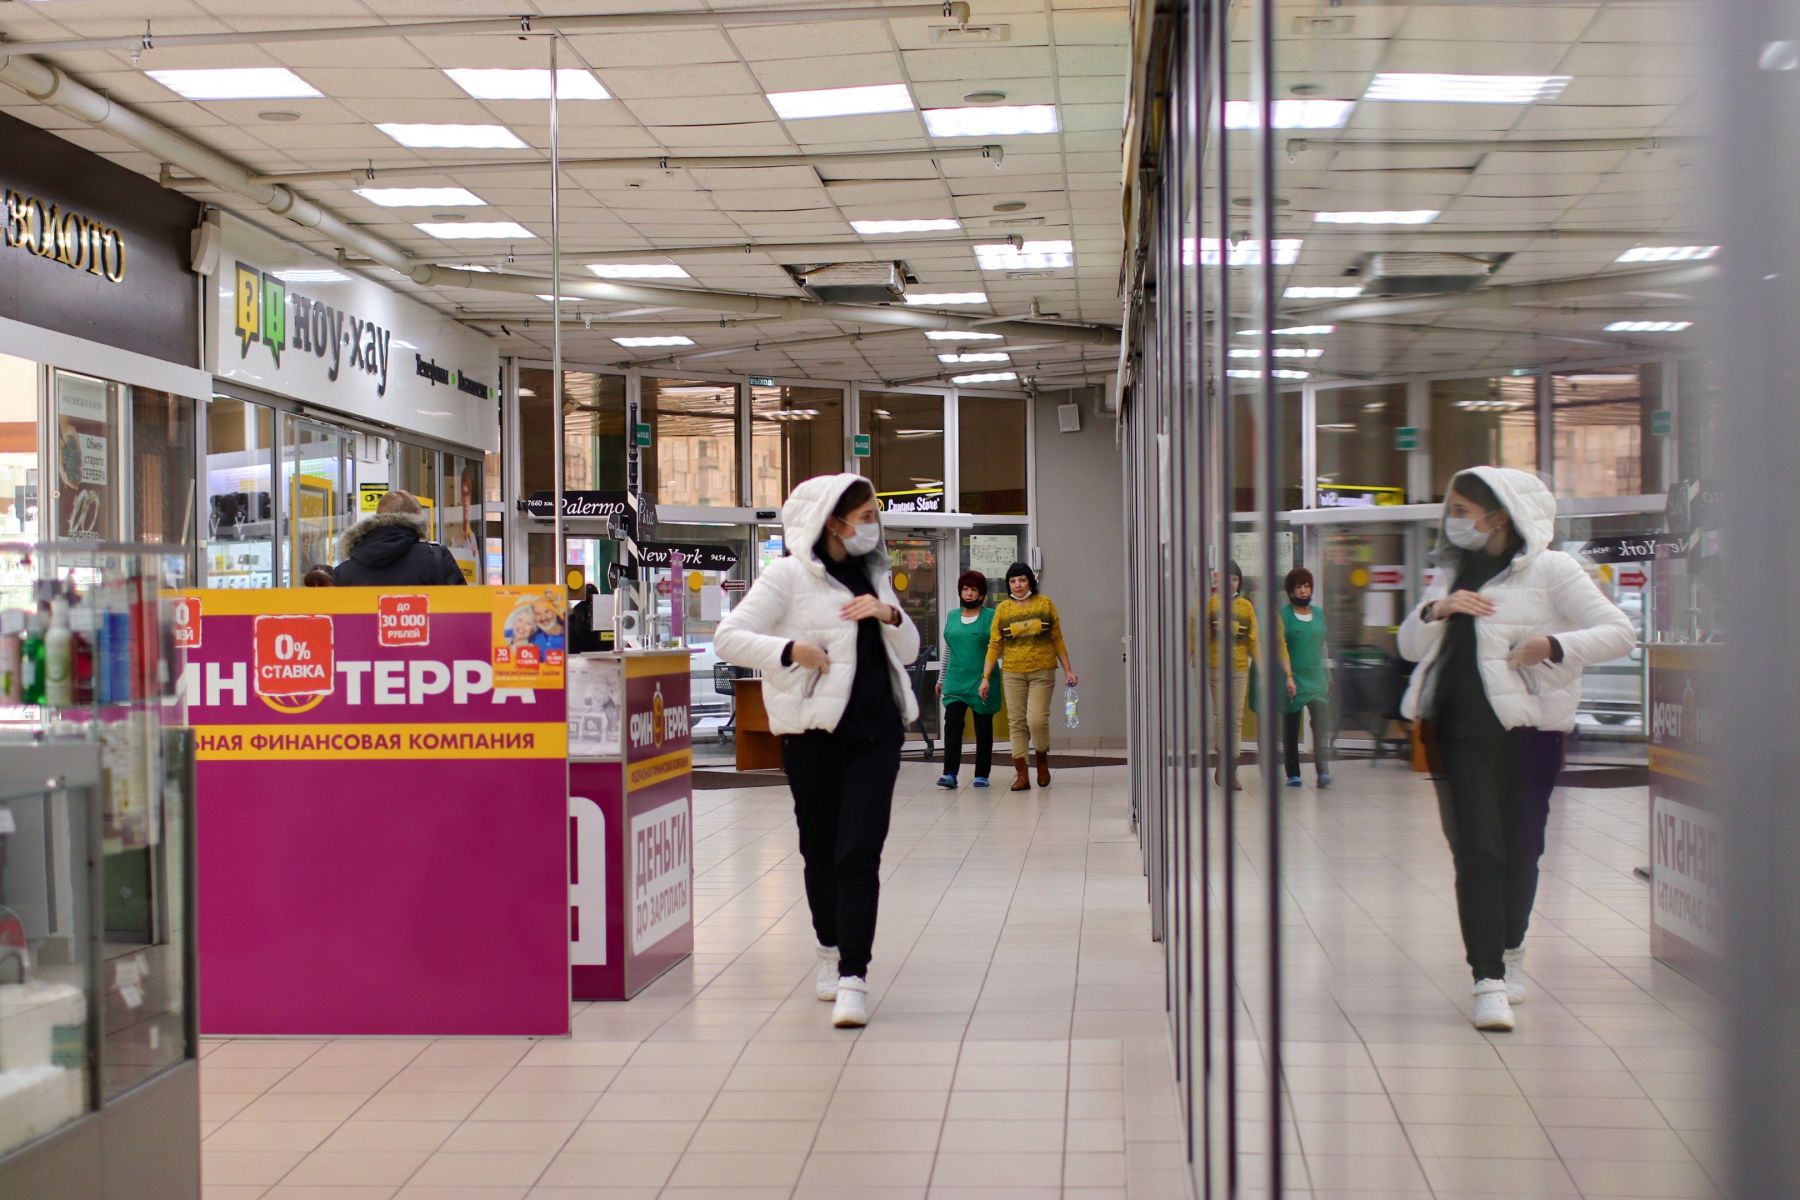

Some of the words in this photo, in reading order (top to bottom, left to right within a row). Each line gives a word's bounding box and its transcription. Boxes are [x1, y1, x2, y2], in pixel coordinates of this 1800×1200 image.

[4, 188, 127, 283] ЗОЛОТО
[527, 499, 543, 507] 7660
[561, 496, 625, 515] Palermo
[637, 547, 667, 562] New
[381, 615, 398, 628] 30
[400, 614, 426, 627] 000
[387, 628, 421, 639] РУБЛЕЙ
[274, 633, 311, 661] 0%
[261, 664, 326, 679] СТАВКА
[630, 710, 654, 749] ФИН
[663, 704, 689, 741] ТЕРРА
[250, 734, 401, 751] ФИНАНСОВАЯ
[409, 732, 535, 750] КОМПАНИЯ
[636, 811, 688, 900] ДЕНЬГИ
[636, 900, 649, 941] ДО
[650, 879, 687, 927] ЗАРПЛАТЫ
